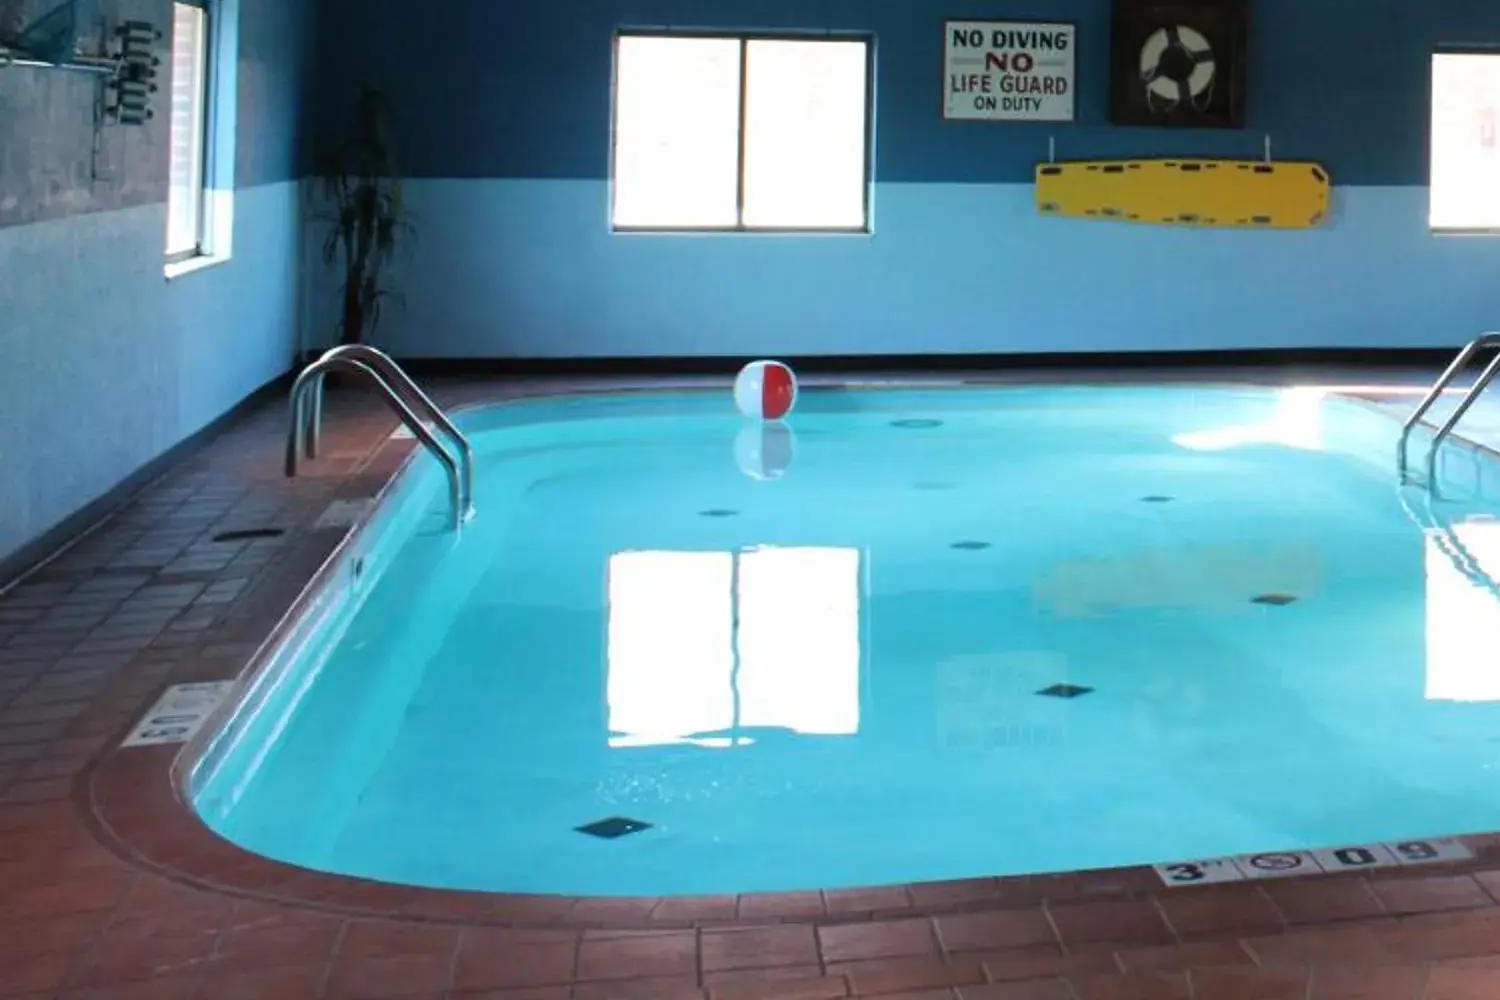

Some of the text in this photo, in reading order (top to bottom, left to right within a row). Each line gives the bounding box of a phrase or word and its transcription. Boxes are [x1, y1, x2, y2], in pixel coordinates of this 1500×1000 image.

[953, 29, 1069, 51] NO DIVING
[985, 51, 1034, 73] NO
[950, 72, 1068, 96] LIFE GUARD
[973, 95, 1043, 112] ON DUTY
